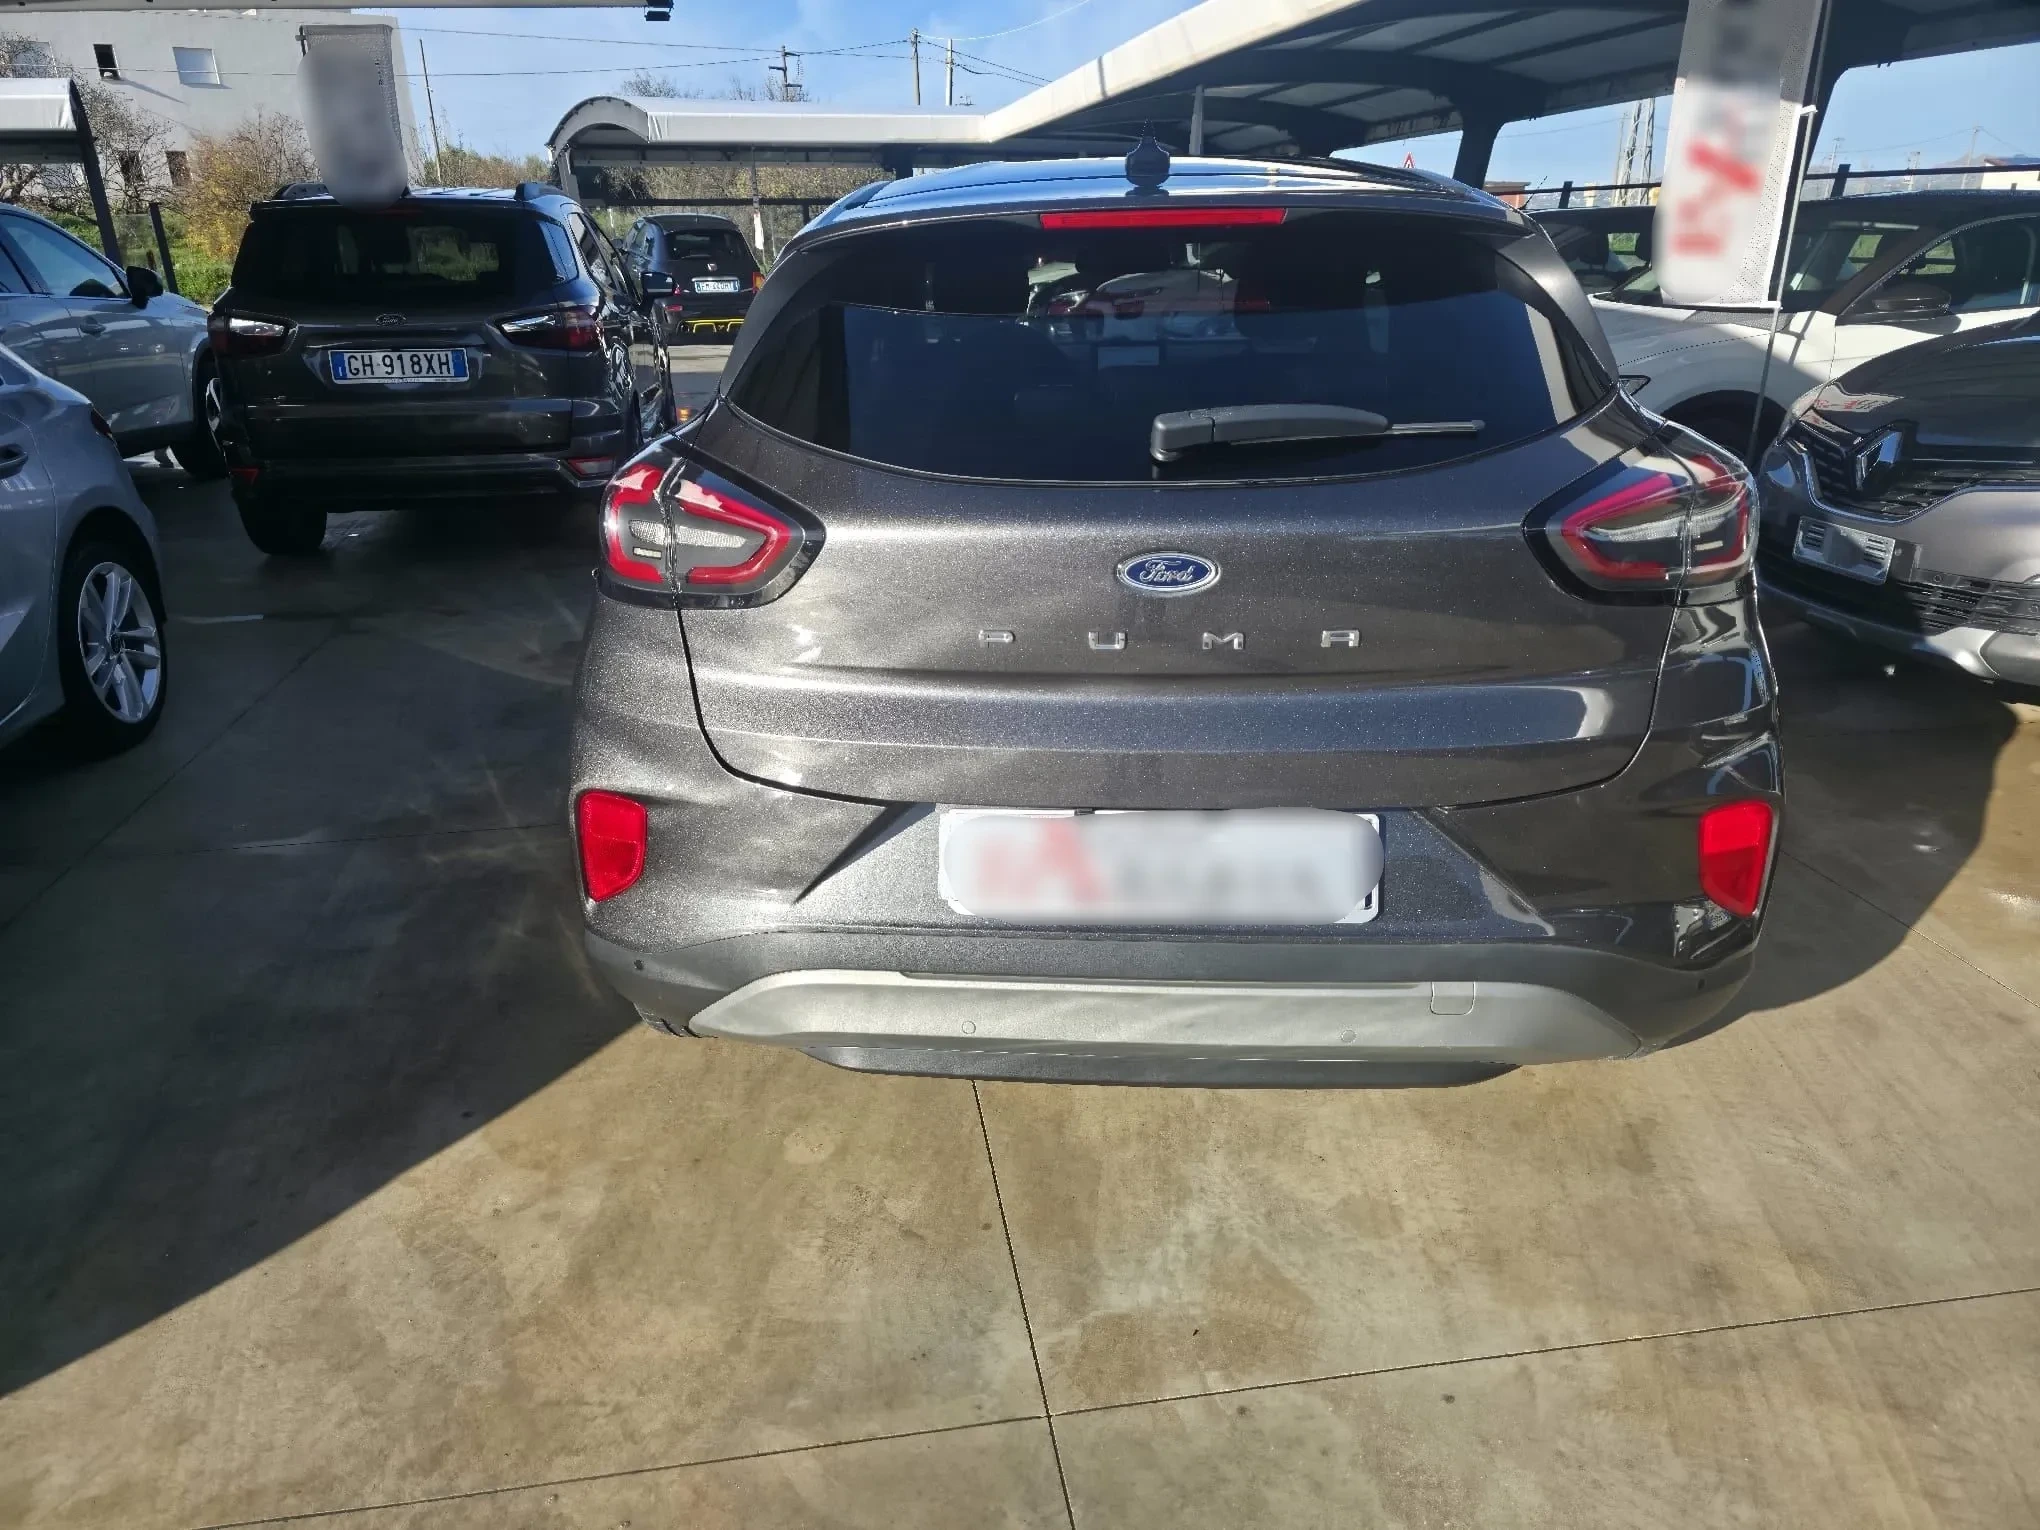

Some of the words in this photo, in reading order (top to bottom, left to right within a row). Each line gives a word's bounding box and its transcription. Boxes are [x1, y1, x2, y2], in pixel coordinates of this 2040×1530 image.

[347, 354, 375, 376] GH
[381, 353, 451, 376] 918XH
[1139, 559, 1197, 583] Ford
[977, 629, 1360, 650] PUMA
